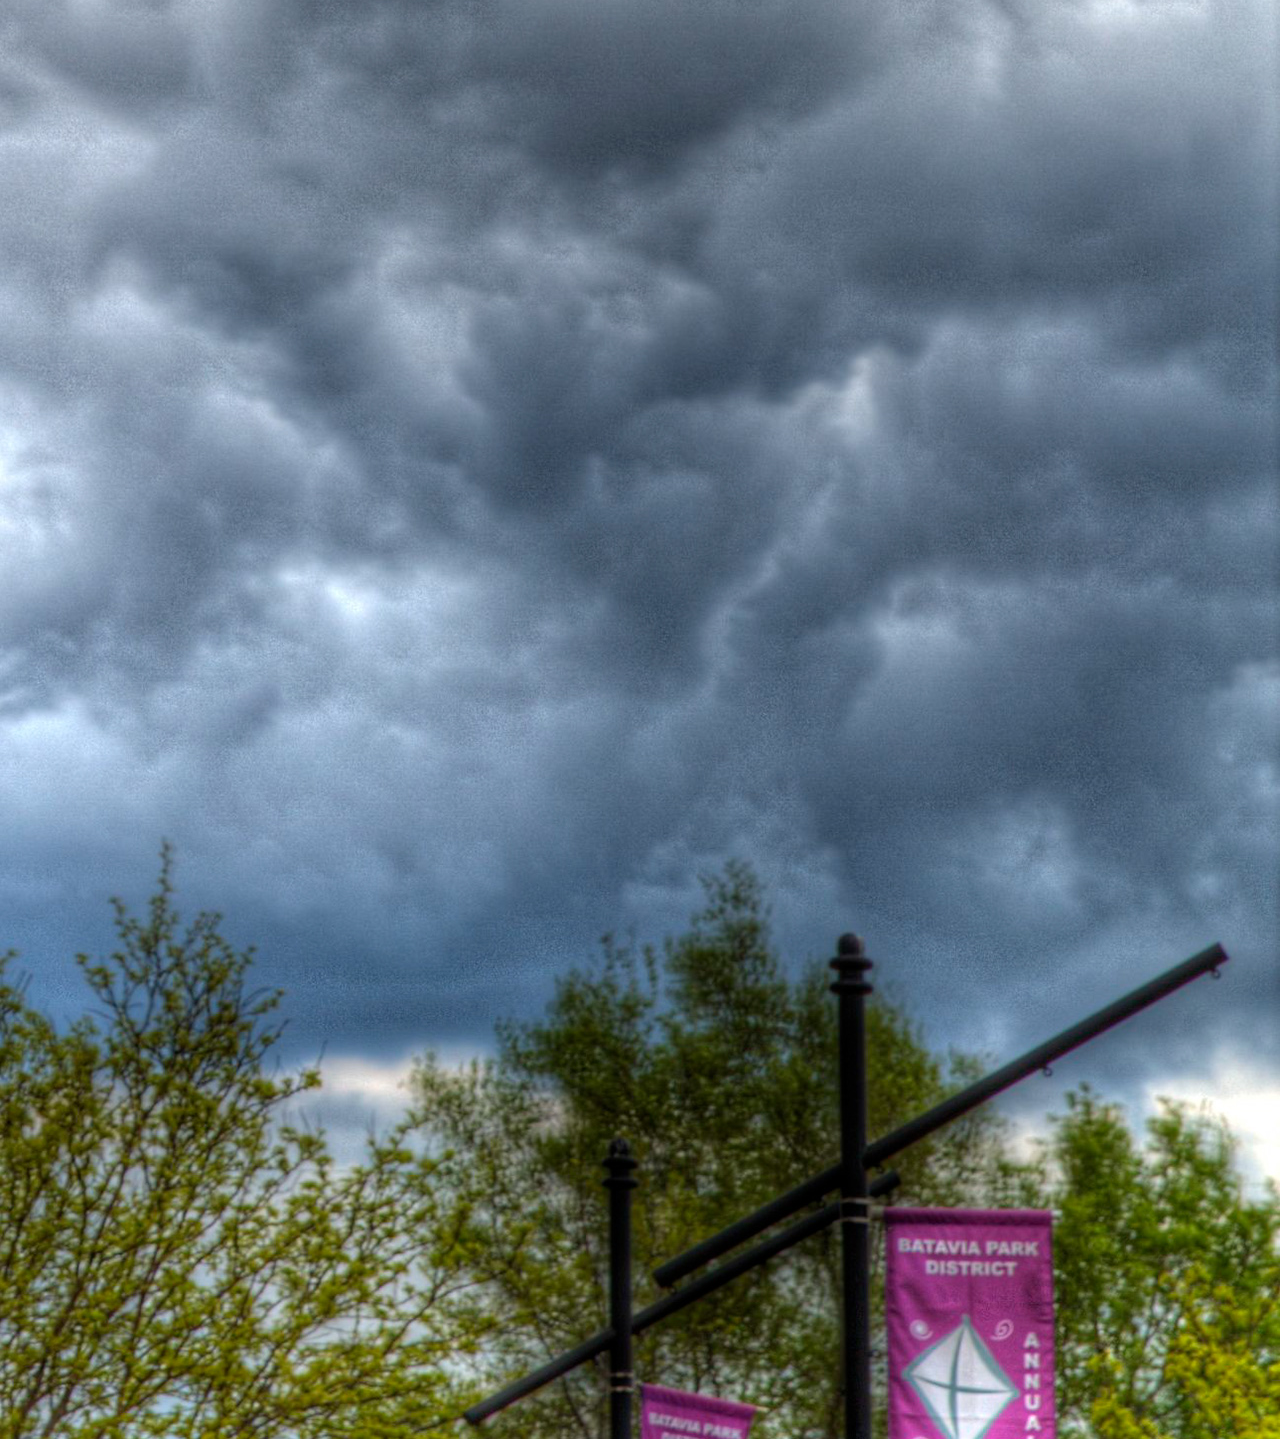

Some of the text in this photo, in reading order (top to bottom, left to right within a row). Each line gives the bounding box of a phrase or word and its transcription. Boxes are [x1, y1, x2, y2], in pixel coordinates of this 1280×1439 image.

[898, 1237, 1040, 1256] BATAVIA PARK
[925, 1260, 1018, 1276] DISTRICT
[649, 1412, 701, 1434] BATAVIA
